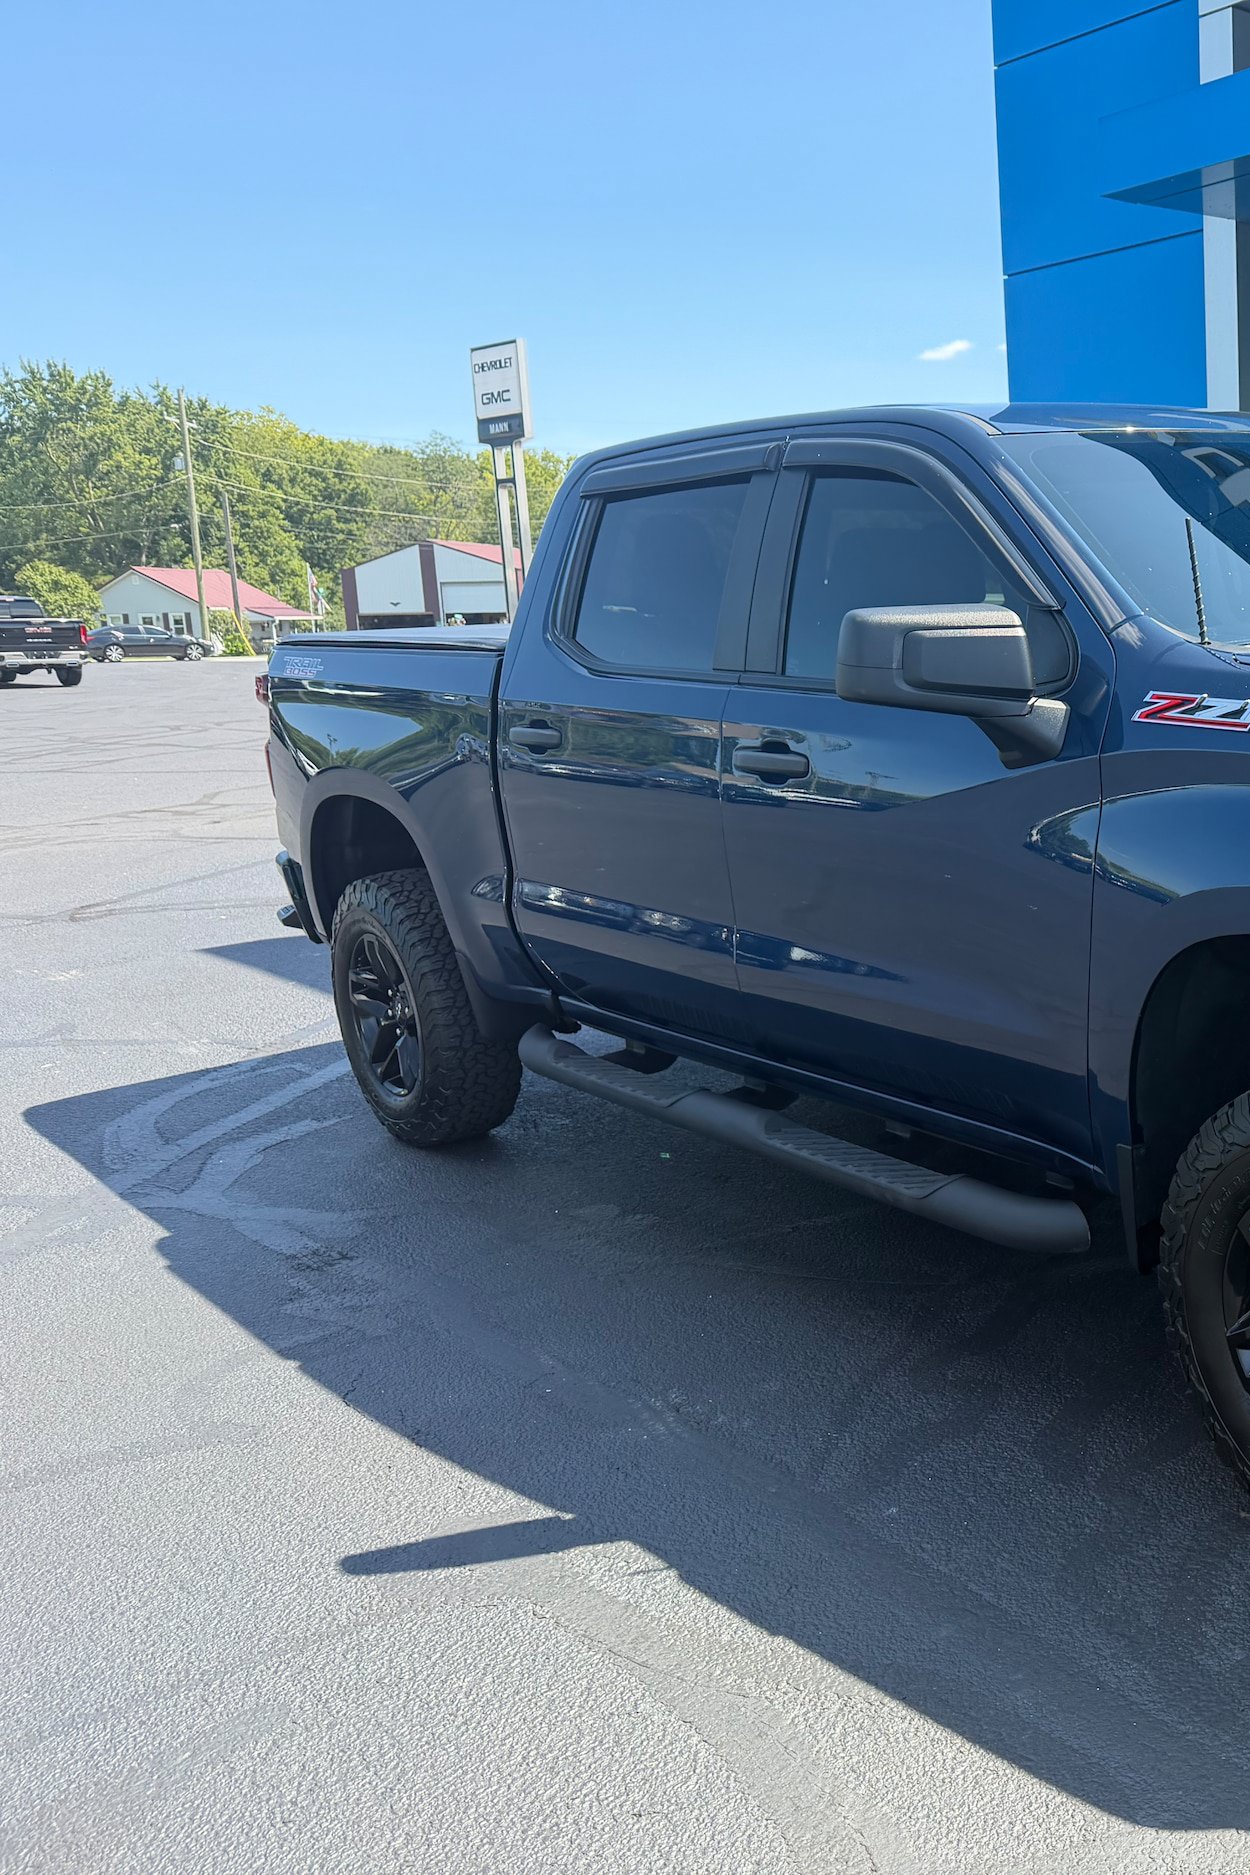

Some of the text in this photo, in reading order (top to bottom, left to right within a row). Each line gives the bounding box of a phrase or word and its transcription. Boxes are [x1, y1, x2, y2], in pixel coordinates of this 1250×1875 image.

[473, 357, 512, 374] CHEVROLET
[481, 389, 511, 405] GMC
[489, 422, 509, 434] MANN
[284, 656, 324, 671] TRAIL
[283, 667, 317, 678] BOSS
